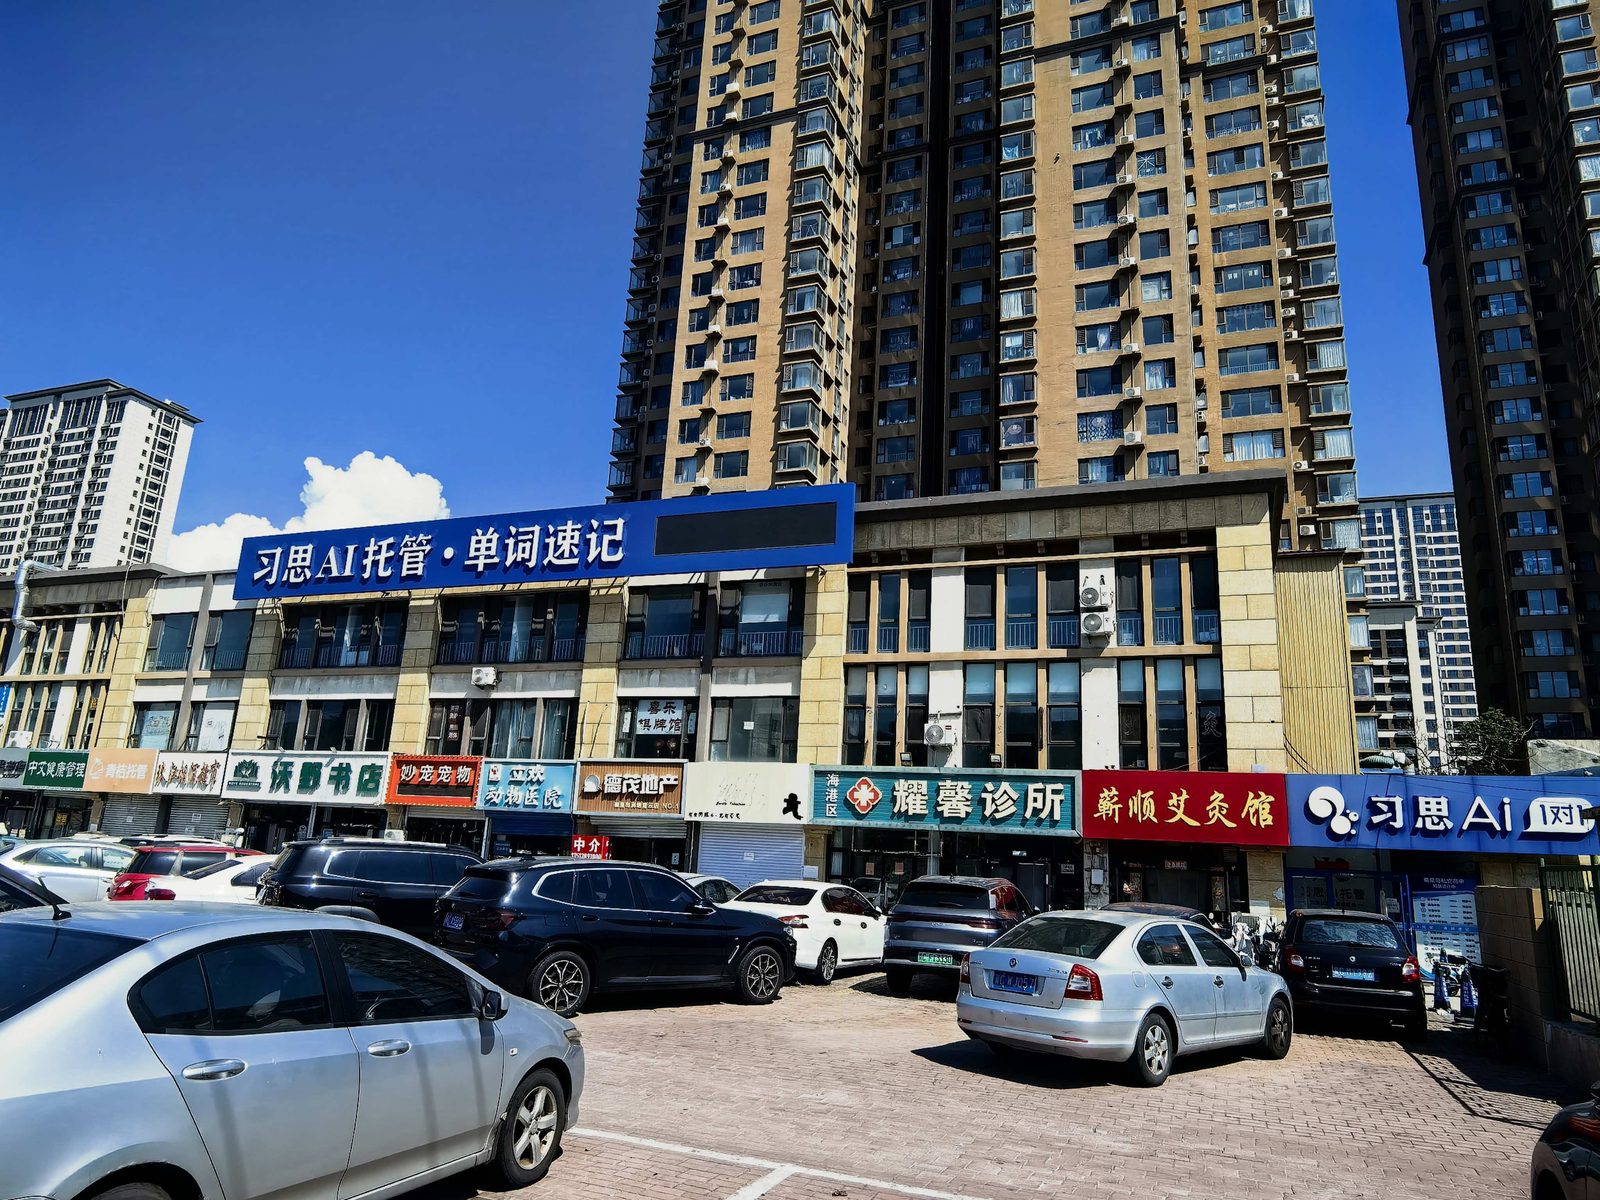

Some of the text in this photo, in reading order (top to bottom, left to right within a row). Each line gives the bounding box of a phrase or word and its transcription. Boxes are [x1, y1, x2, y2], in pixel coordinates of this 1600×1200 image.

[638, 718, 682, 731] 棋牌馆
[400, 764, 472, 783] 妙宠宠物
[509, 764, 545, 783] 立欢
[604, 773, 679, 795] 德茂地产
[486, 785, 562, 808] 动物医院
[825, 773, 841, 818] 海港区
[893, 779, 1066, 821] 耀馨诊所
[1093, 786, 1276, 829] 蕲顺艾灸馆
[1371, 795, 1585, 832] 习思Ai 1对1
[573, 837, 601, 853] 中介
